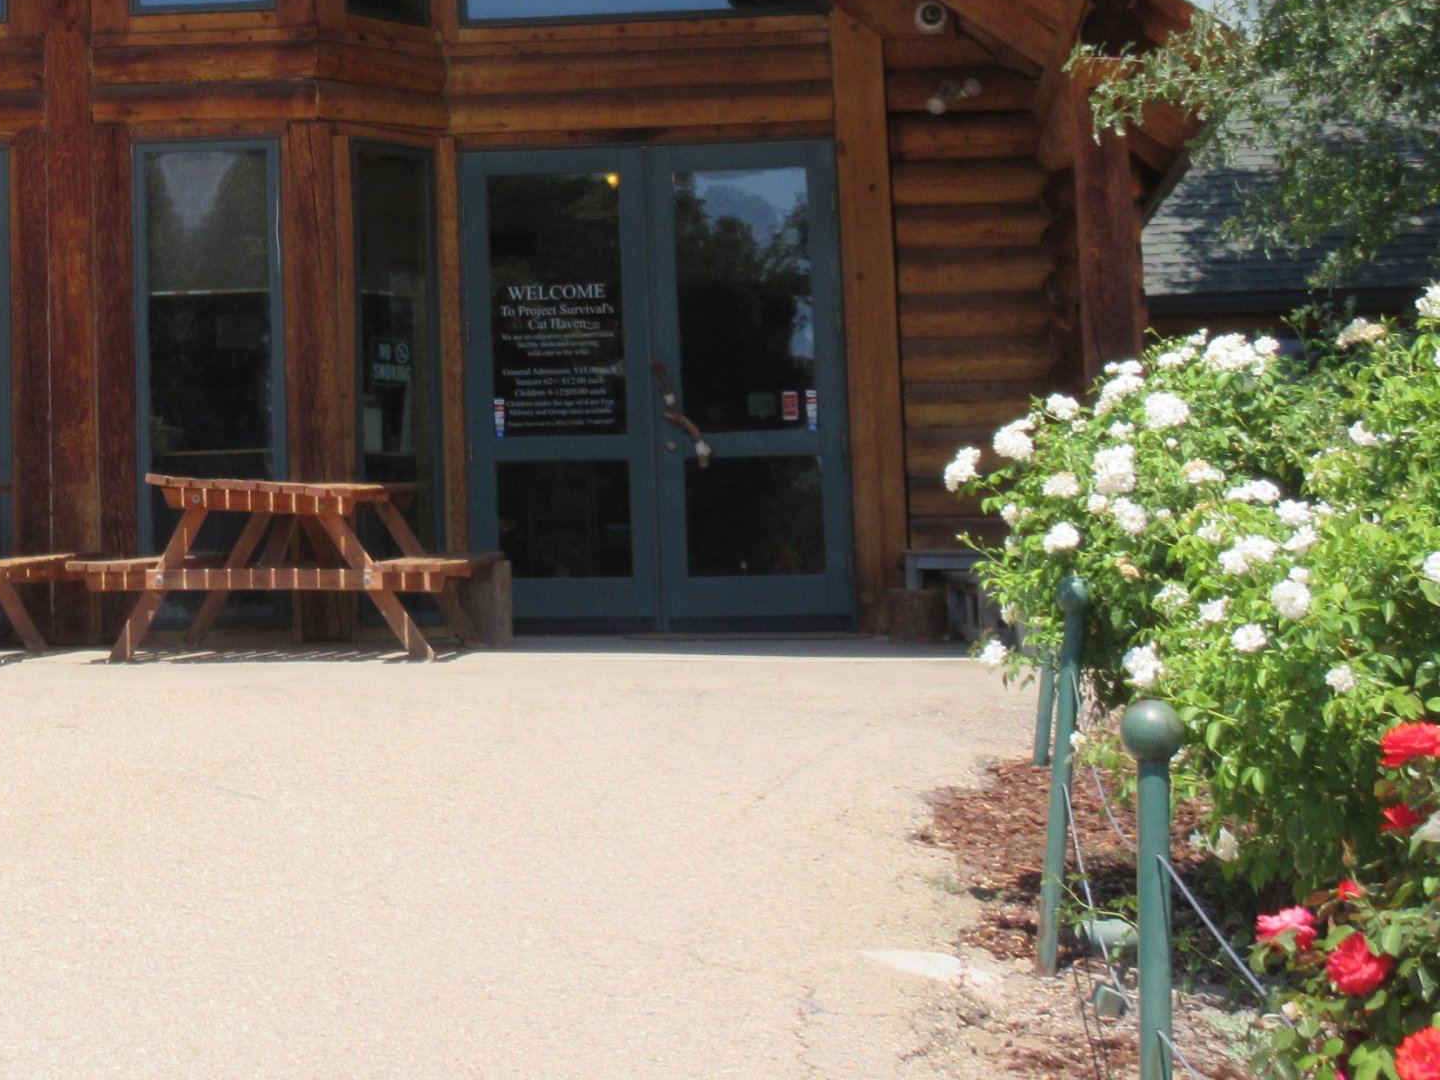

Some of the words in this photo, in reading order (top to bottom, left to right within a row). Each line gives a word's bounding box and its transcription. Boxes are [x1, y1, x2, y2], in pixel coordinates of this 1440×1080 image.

[507, 283, 606, 300] WELCOME
[500, 306, 516, 317] To
[518, 305, 556, 318] Project
[560, 303, 614, 315] Survival's
[528, 319, 548, 330] Cat
[550, 318, 586, 329] Haven
[379, 343, 391, 360] NO
[373, 363, 411, 384] SMOKING
[502, 368, 531, 376] General
[514, 388, 546, 397] Children
